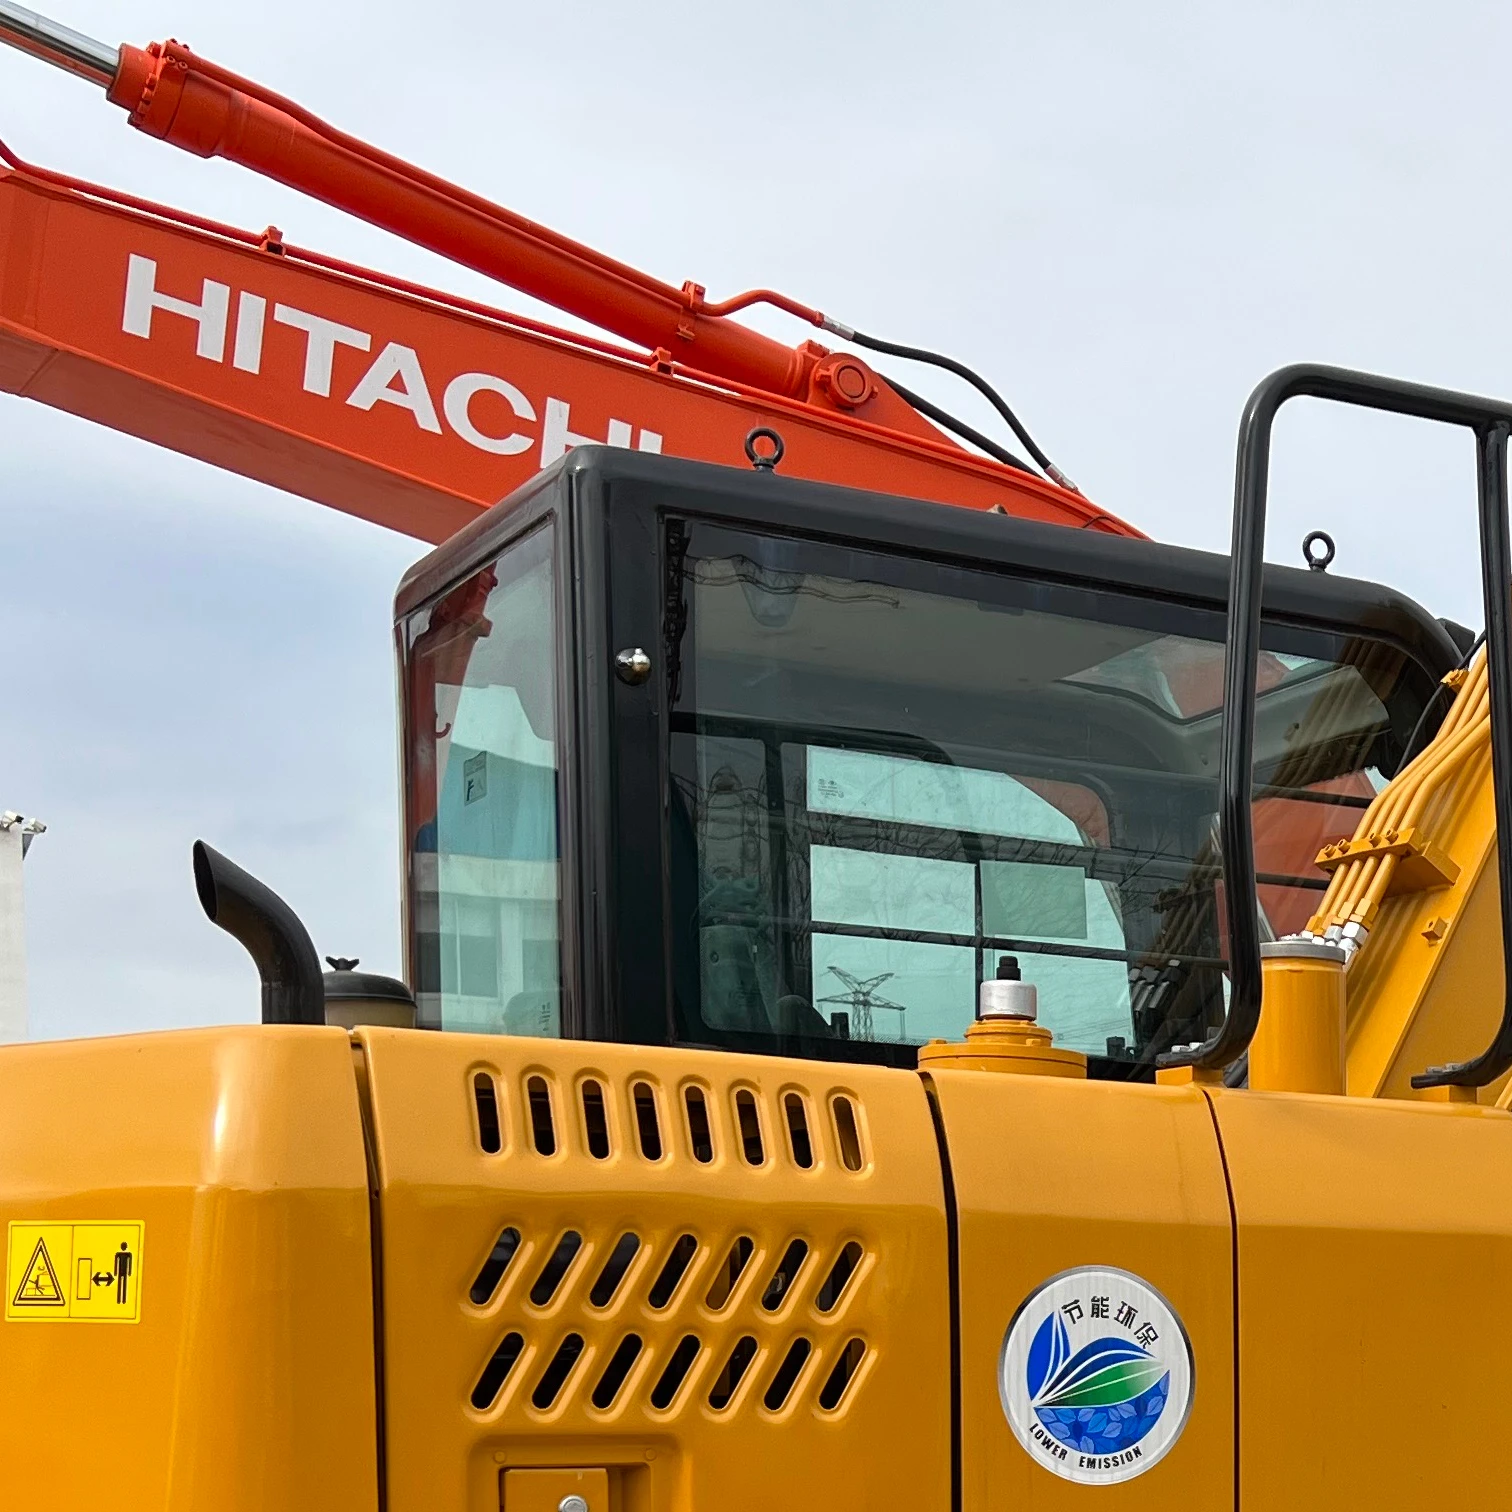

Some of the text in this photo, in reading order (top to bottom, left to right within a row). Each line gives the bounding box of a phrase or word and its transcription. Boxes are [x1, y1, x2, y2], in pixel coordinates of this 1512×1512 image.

[1061, 1295, 1159, 1349] 节能环保
[1029, 1422, 1143, 1470] LOWER EMISSION
